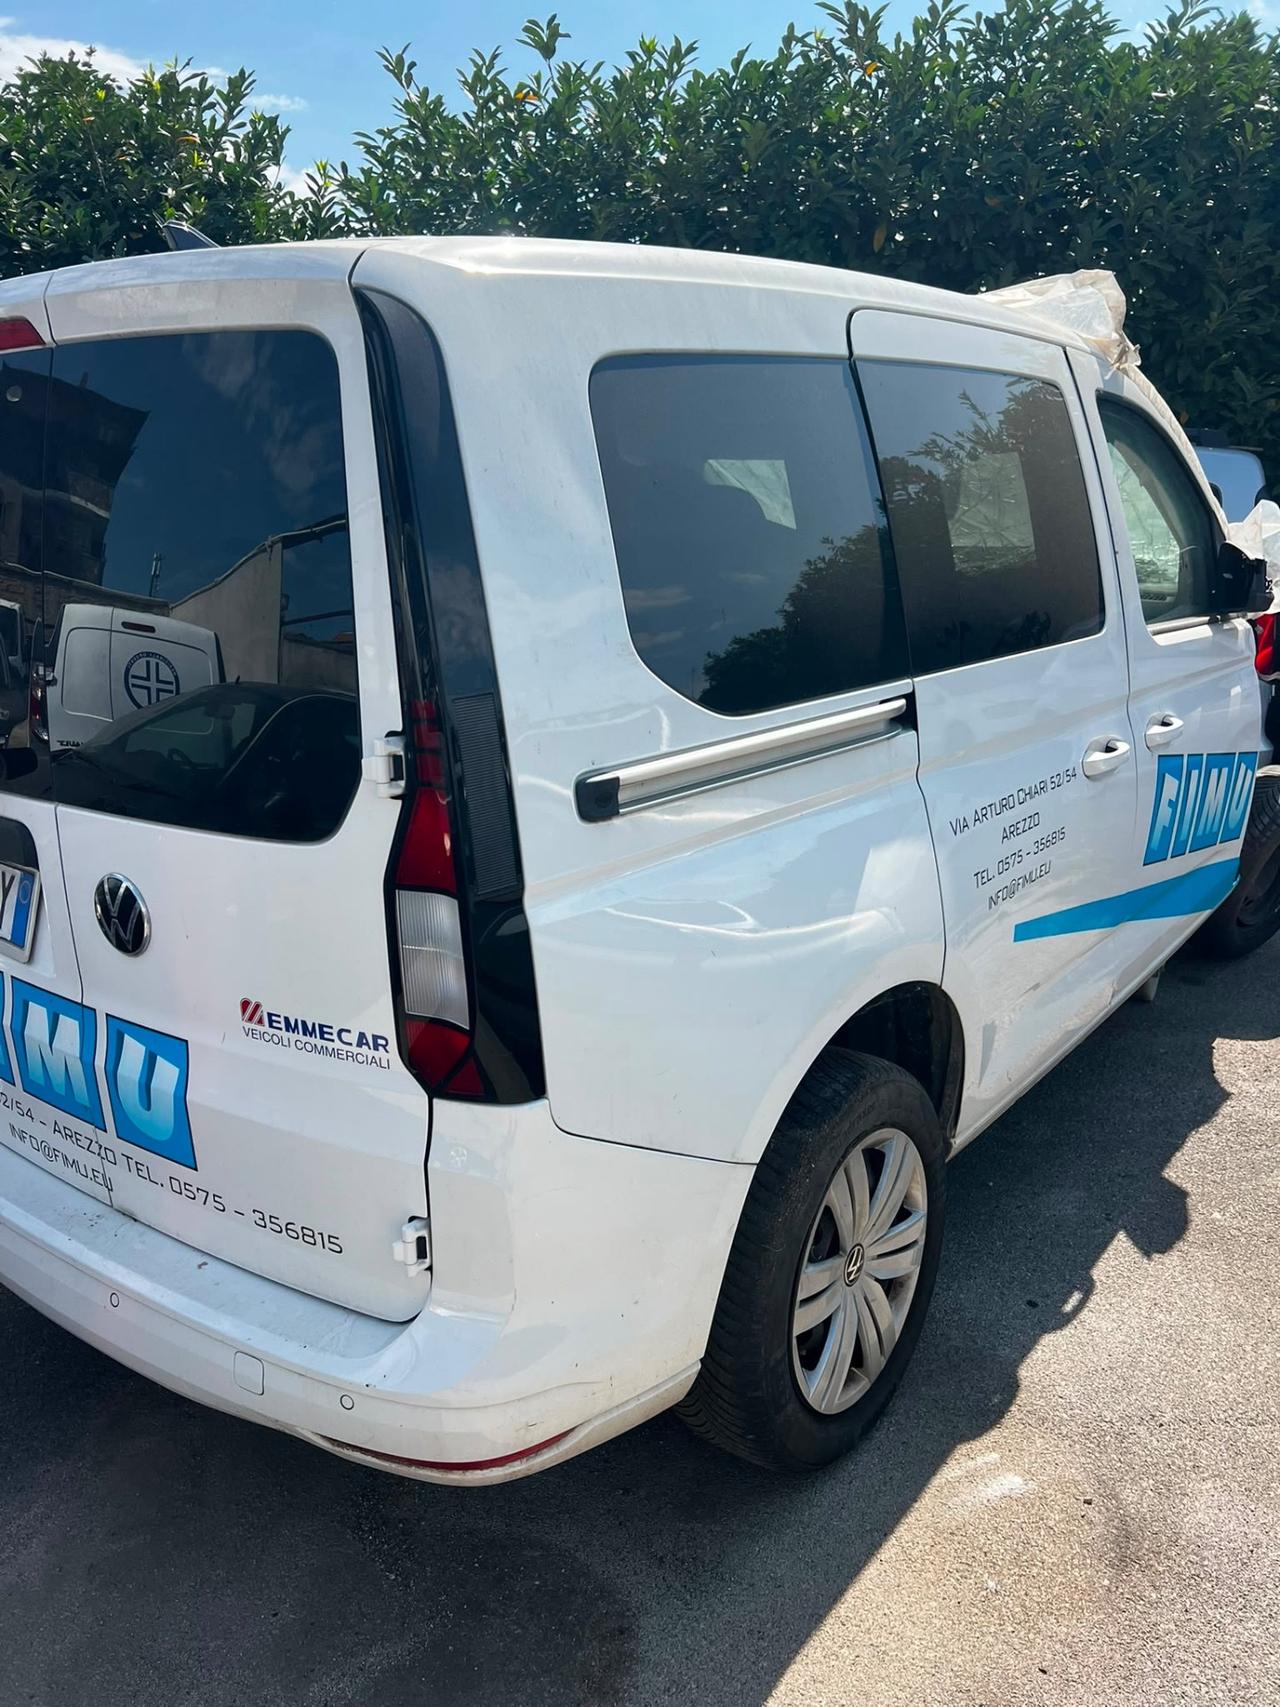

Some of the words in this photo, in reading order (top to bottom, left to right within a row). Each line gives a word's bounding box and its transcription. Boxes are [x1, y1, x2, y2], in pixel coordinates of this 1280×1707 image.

[949, 817, 970, 837] VIA
[973, 793, 1016, 827] ARTURO
[1017, 779, 1049, 805] CHIARI
[1050, 766, 1077, 790] 52/54
[1001, 812, 1041, 844] AREZZO
[1149, 759, 1254, 852] FIMU
[973, 867, 996, 889] TEL.
[997, 849, 1024, 876] 0575
[1033, 826, 1066, 855] 356815
[988, 860, 1052, 910] INFO@FIMU.EU
[242, 1026, 291, 1048] VEICOLI
[294, 1039, 391, 1070] COMMERCIALI
[266, 1011, 390, 1054] EMMECAR
[0, 998, 182, 1143] MU
[8, 1122, 114, 1193] INFO@FIMU.EU
[53, 1119, 117, 1166] AREZZO
[121, 1153, 164, 1188] TEL.
[169, 1175, 226, 1213] 0575
[252, 1209, 344, 1255] 356815
